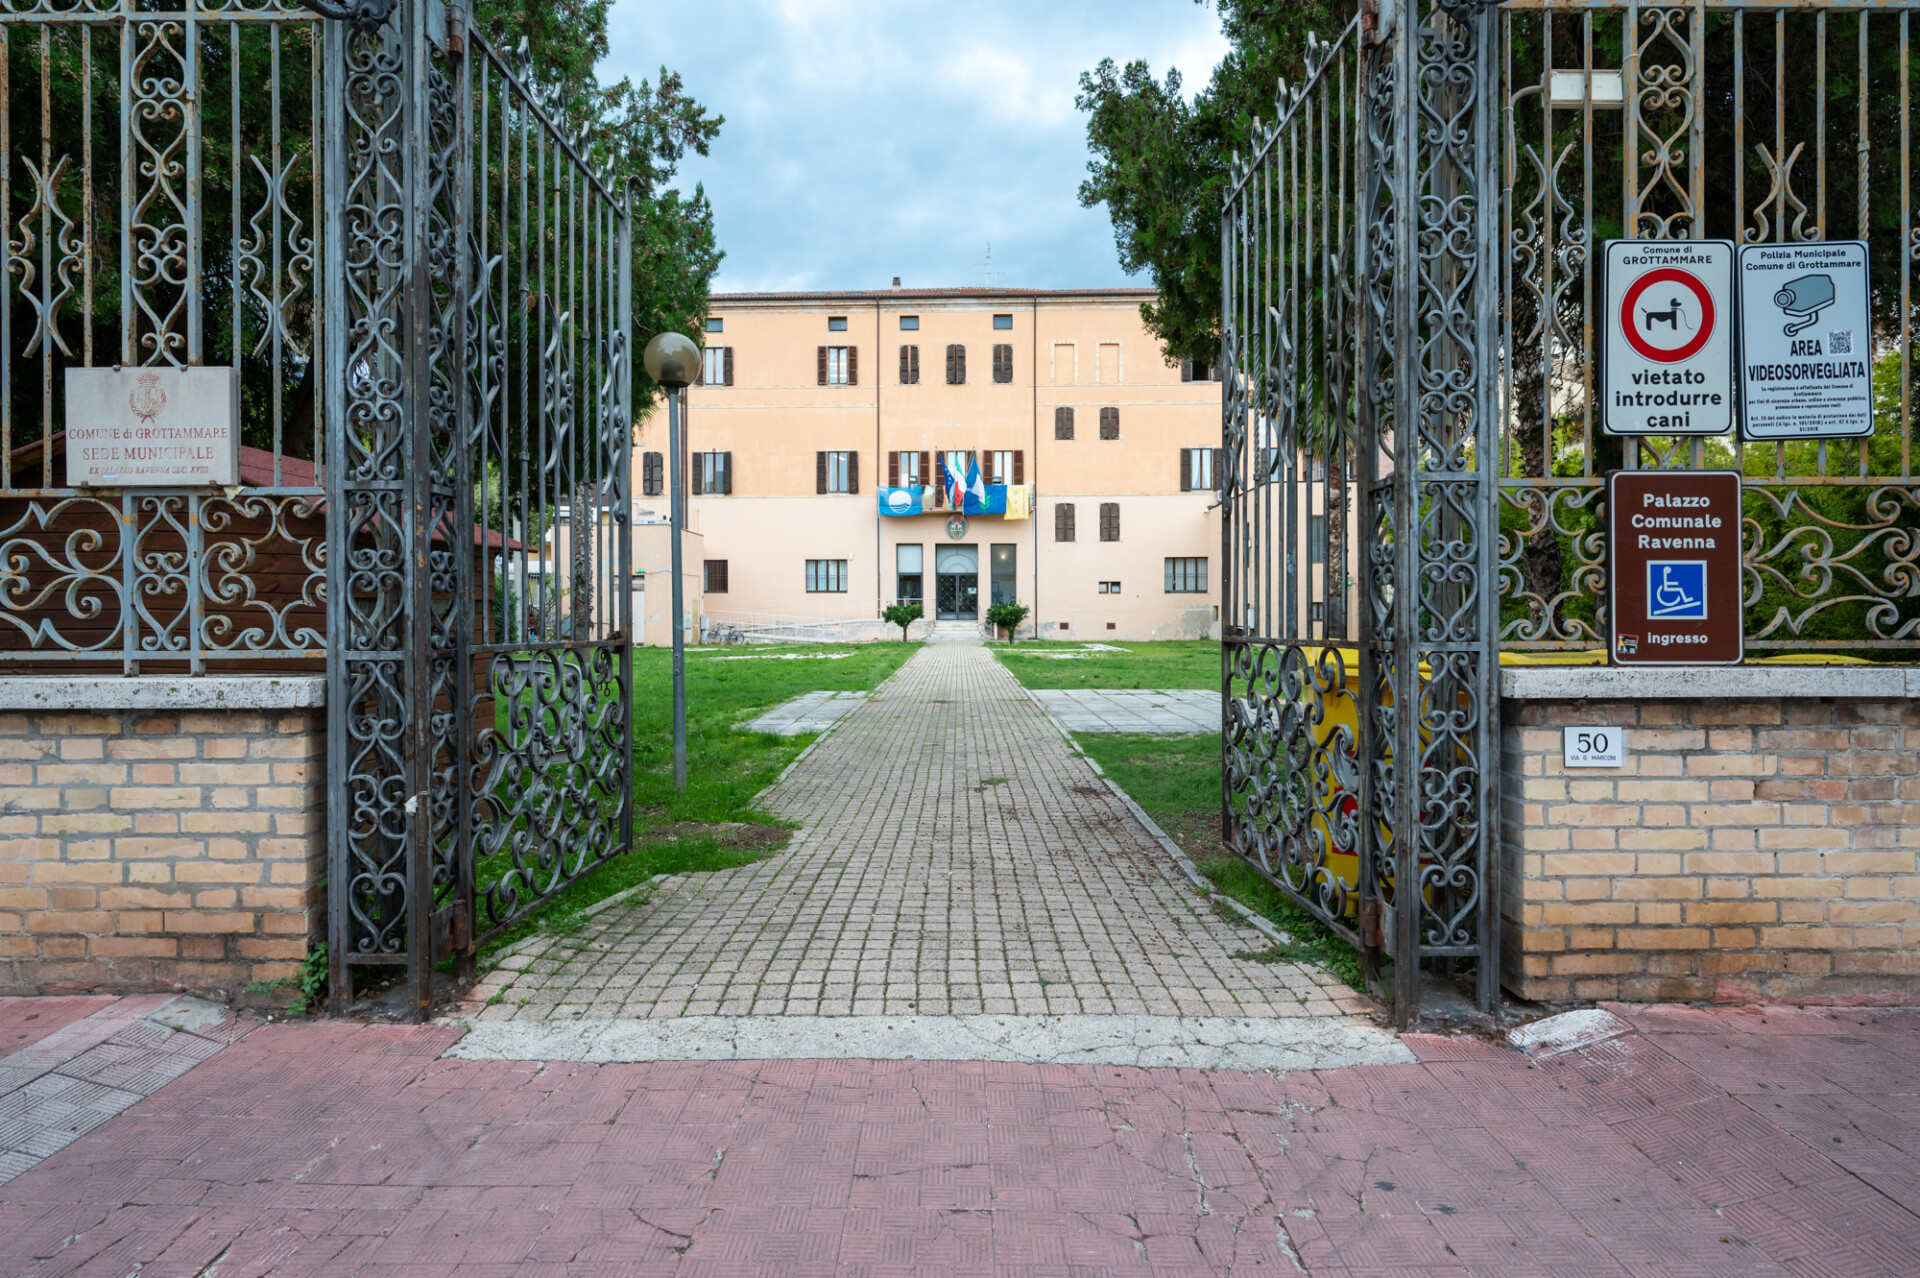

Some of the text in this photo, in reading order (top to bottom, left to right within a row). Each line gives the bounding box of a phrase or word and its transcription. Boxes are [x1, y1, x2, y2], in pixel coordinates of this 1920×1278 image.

[1643, 246, 1692, 254] Comune di
[1760, 250, 1846, 260] Polizia Municipale
[1623, 256, 1712, 265] GROTTAMMARE
[1746, 260, 1862, 271] Comune di Grottammare
[1790, 339, 1822, 356] AREA
[1632, 369, 1705, 385] vietato
[1748, 362, 1866, 381] VIDEOSORVEGLIATA
[1616, 390, 1722, 406] introdurre
[1646, 411, 1690, 427] cani
[68, 428, 228, 439] COMUNE di GROTTAMMARE
[82, 446, 214, 460] SEDE MUNICIPALE
[89, 466, 99, 474] EX
[135, 466, 170, 474] RAVENNA
[1643, 493, 1710, 508] Palazzo
[1631, 514, 1722, 528] Comunale
[1638, 534, 1716, 549] Ravenna
[1648, 632, 1708, 646] ingresso
[1577, 733, 1608, 753] 50
